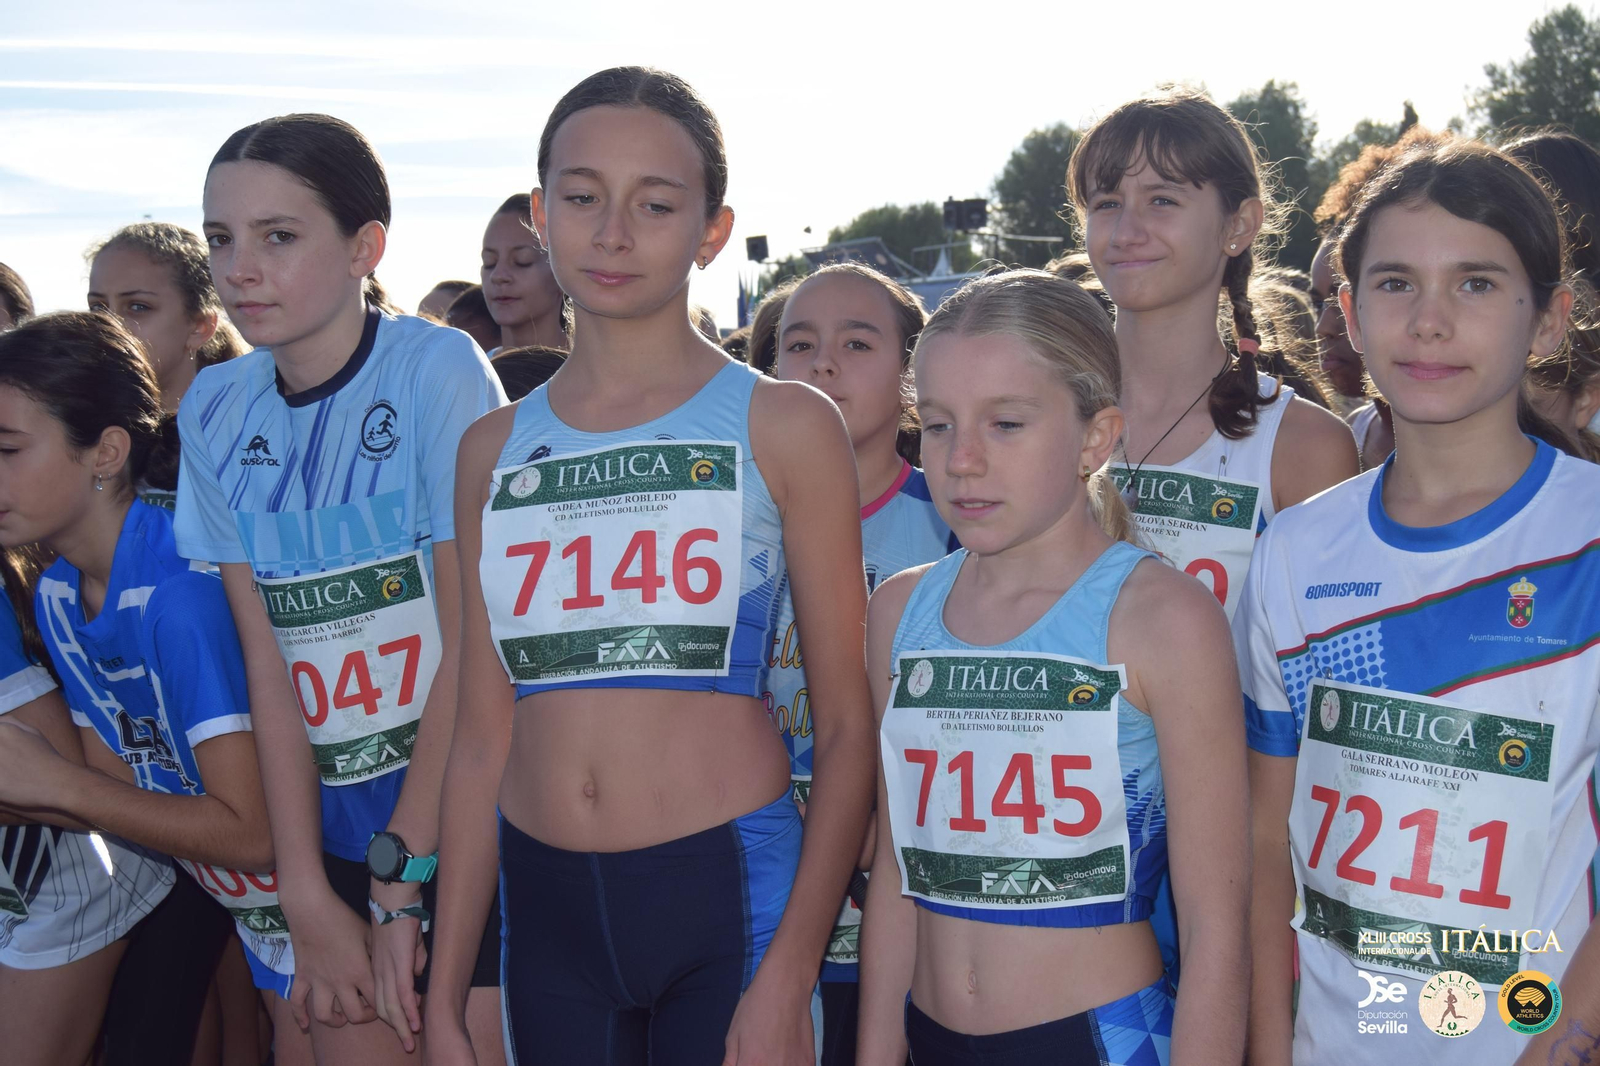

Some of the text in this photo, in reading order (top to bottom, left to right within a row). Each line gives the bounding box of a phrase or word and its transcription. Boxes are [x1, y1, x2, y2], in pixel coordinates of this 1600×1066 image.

[557, 453, 671, 487] ITÁLICA
[614, 478, 635, 487] CROSS
[637, 475, 671, 483] COUNTRY
[548, 492, 677, 514] GADEA MUÑOZ ROBLEDO
[555, 504, 669, 522] CD ATLETISMO BOLLULLOS
[1165, 529, 1180, 538] XXI
[505, 528, 723, 616] 7146
[268, 579, 366, 613] ITÁLICA
[1304, 582, 1383, 600] BORDISPORT
[291, 626, 325, 637] GARCIA
[326, 613, 376, 631] VILLEGAS
[314, 634, 331, 643] DEL
[332, 627, 363, 640] BARRIO
[686, 641, 720, 651] docunova
[1468, 633, 1568, 646] Ayuntamiento de Tomares
[580, 664, 619, 675] ANDALUZA
[622, 663, 631, 671] DE
[947, 659, 1050, 692] ITÁLICA
[926, 709, 1064, 722] BERTHA PERIAÑEZ BEJERANO
[1349, 699, 1478, 750] ITÁLICA
[941, 722, 1044, 733] CD ATLETISMO BOLLULLOS
[1349, 729, 1478, 759] INTERNATIONAL CROSS COUNTRY
[360, 770, 370, 778] DE
[372, 756, 407, 774] ATLETISMO
[1341, 748, 1479, 783] GALA SERRANO MOLEÓN
[1349, 763, 1461, 792] TOMARES ALJARAFE XXI
[904, 748, 1103, 837] 7145
[1307, 784, 1514, 910] 7211
[1073, 864, 1117, 879] docunova
[929, 890, 962, 901] FEDERACIÓN
[964, 896, 1003, 905] ANDALUZA
[1020, 894, 1066, 905] ATLETISMO
[1382, 959, 1394, 968] DE
